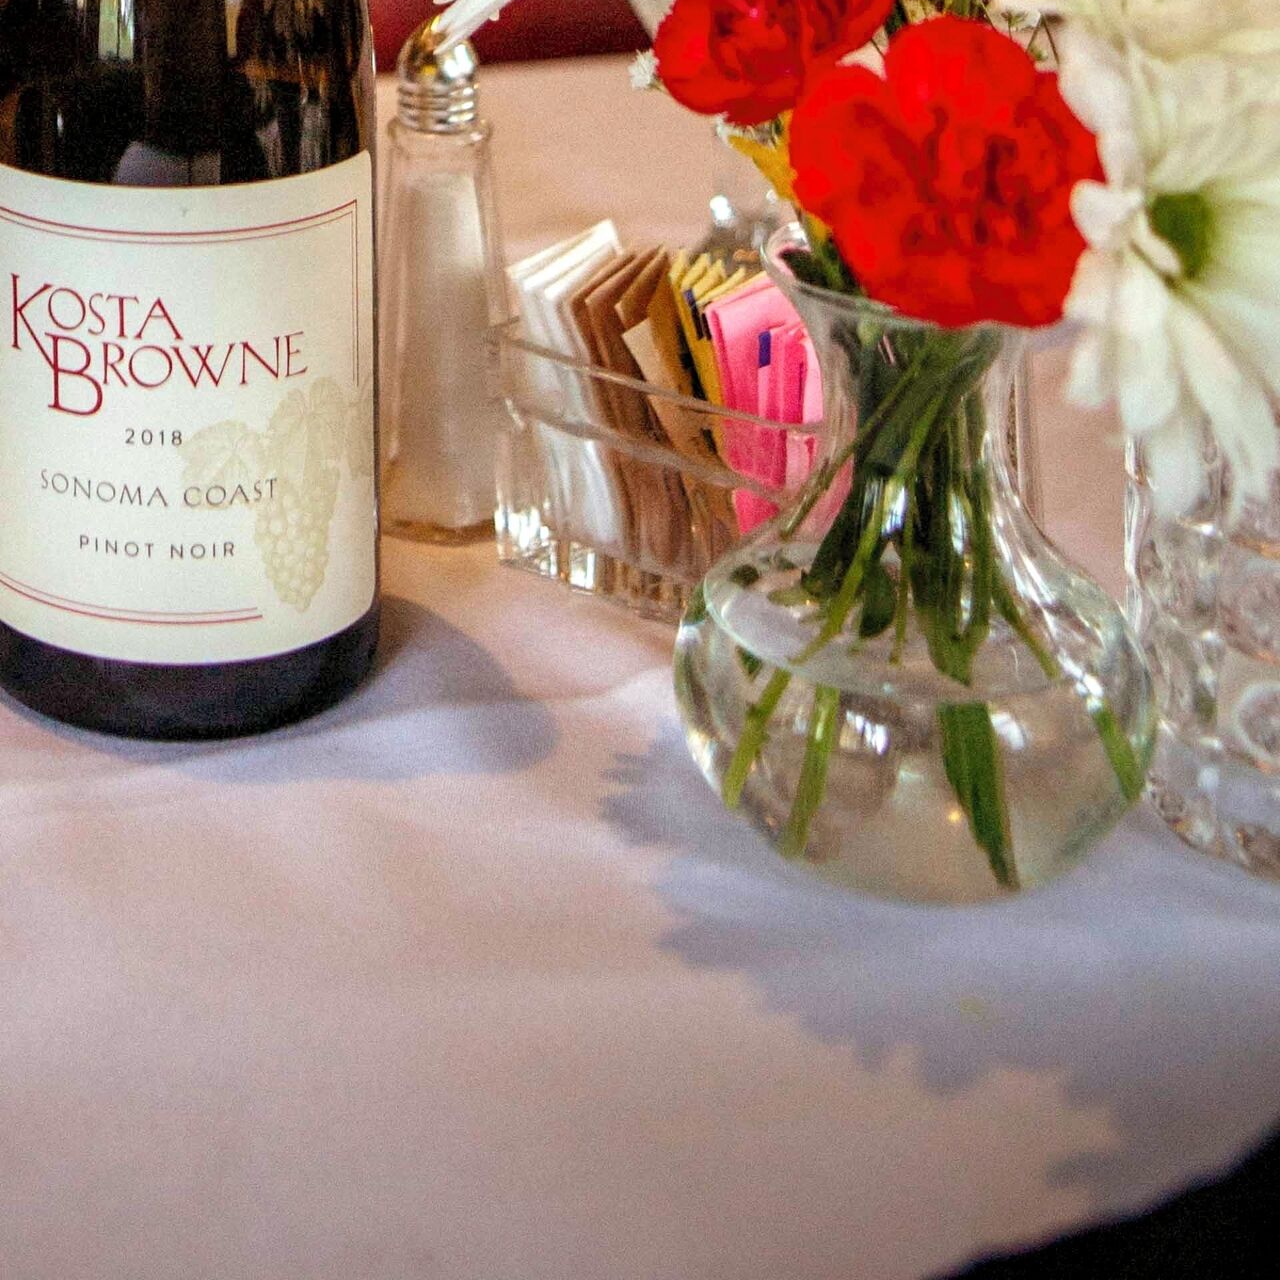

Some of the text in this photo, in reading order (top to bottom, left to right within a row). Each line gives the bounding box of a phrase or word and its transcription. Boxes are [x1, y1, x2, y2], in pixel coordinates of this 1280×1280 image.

[10, 273, 184, 368] KOSTA
[45, 330, 309, 417] BROWNE
[124, 428, 183, 447] 2018
[40, 469, 278, 508] SONOMA COAST
[79, 535, 235, 559] PINOT NOIR
